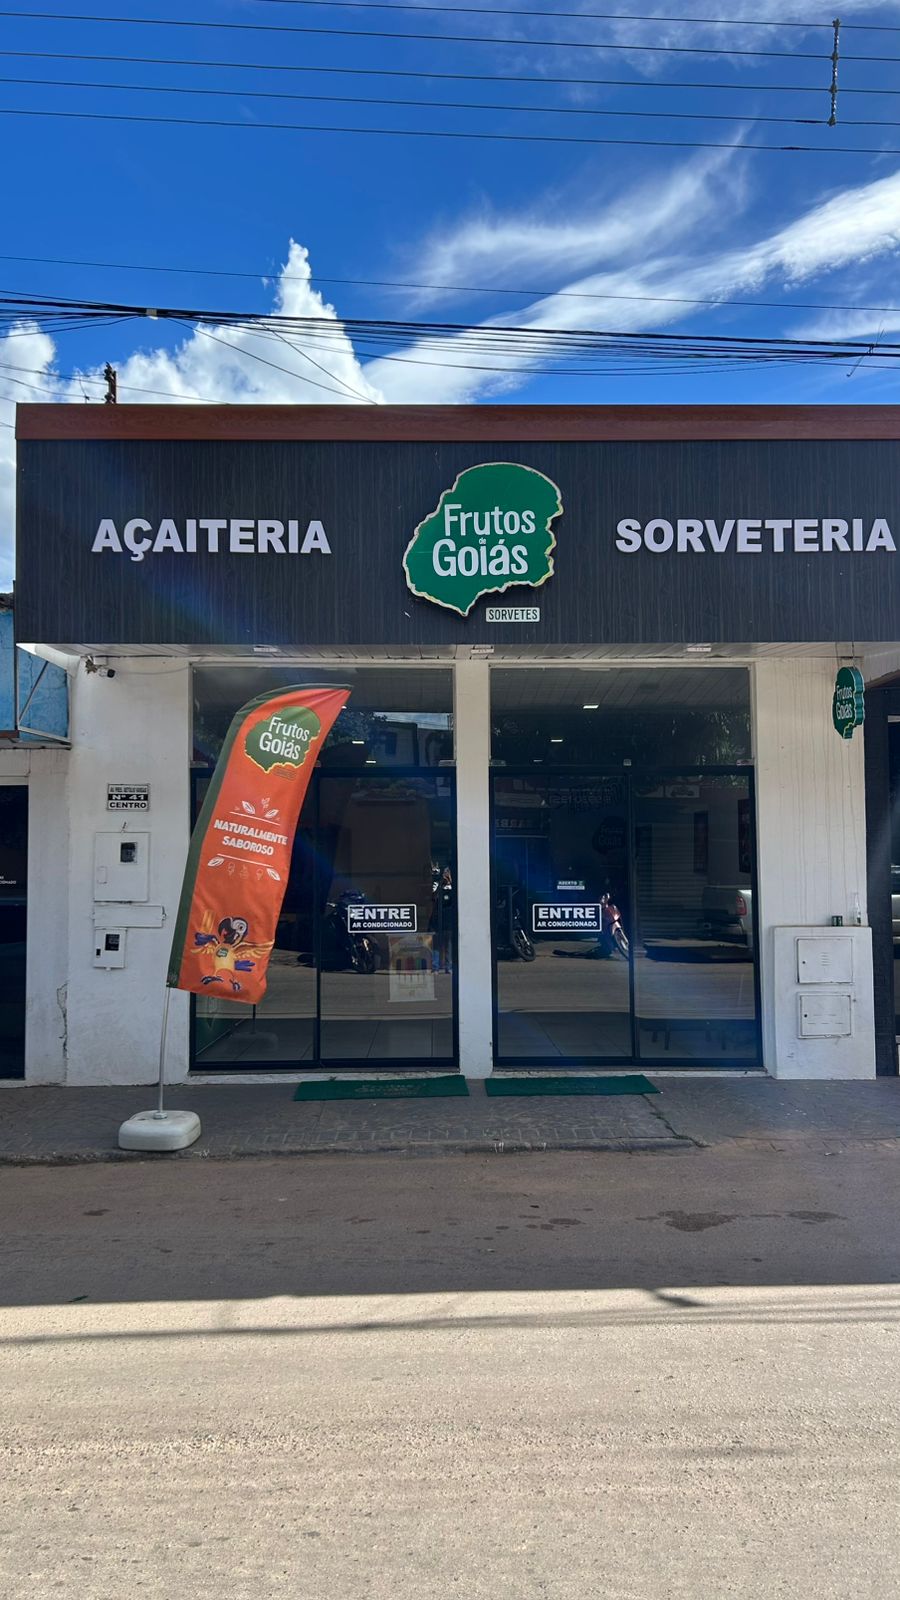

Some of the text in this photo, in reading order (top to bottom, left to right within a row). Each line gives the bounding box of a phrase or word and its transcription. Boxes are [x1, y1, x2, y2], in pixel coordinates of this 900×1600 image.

[444, 503, 536, 537] Frutos
[91, 518, 332, 562] AÇAITERIA
[615, 518, 897, 553] SORVETERIA
[432, 538, 529, 577] Goiás
[488, 608, 538, 621] SORVETES
[836, 684, 853, 700] Frutos
[268, 716, 310, 742] Frutos
[259, 732, 301, 760] Goiás
[109, 801, 147, 809] CENTRO
[213, 819, 288, 846] NATURALMENTE
[222, 835, 274, 856] SABOROSO
[353, 908, 411, 920] ENTRE
[538, 907, 596, 919] ENTRE
